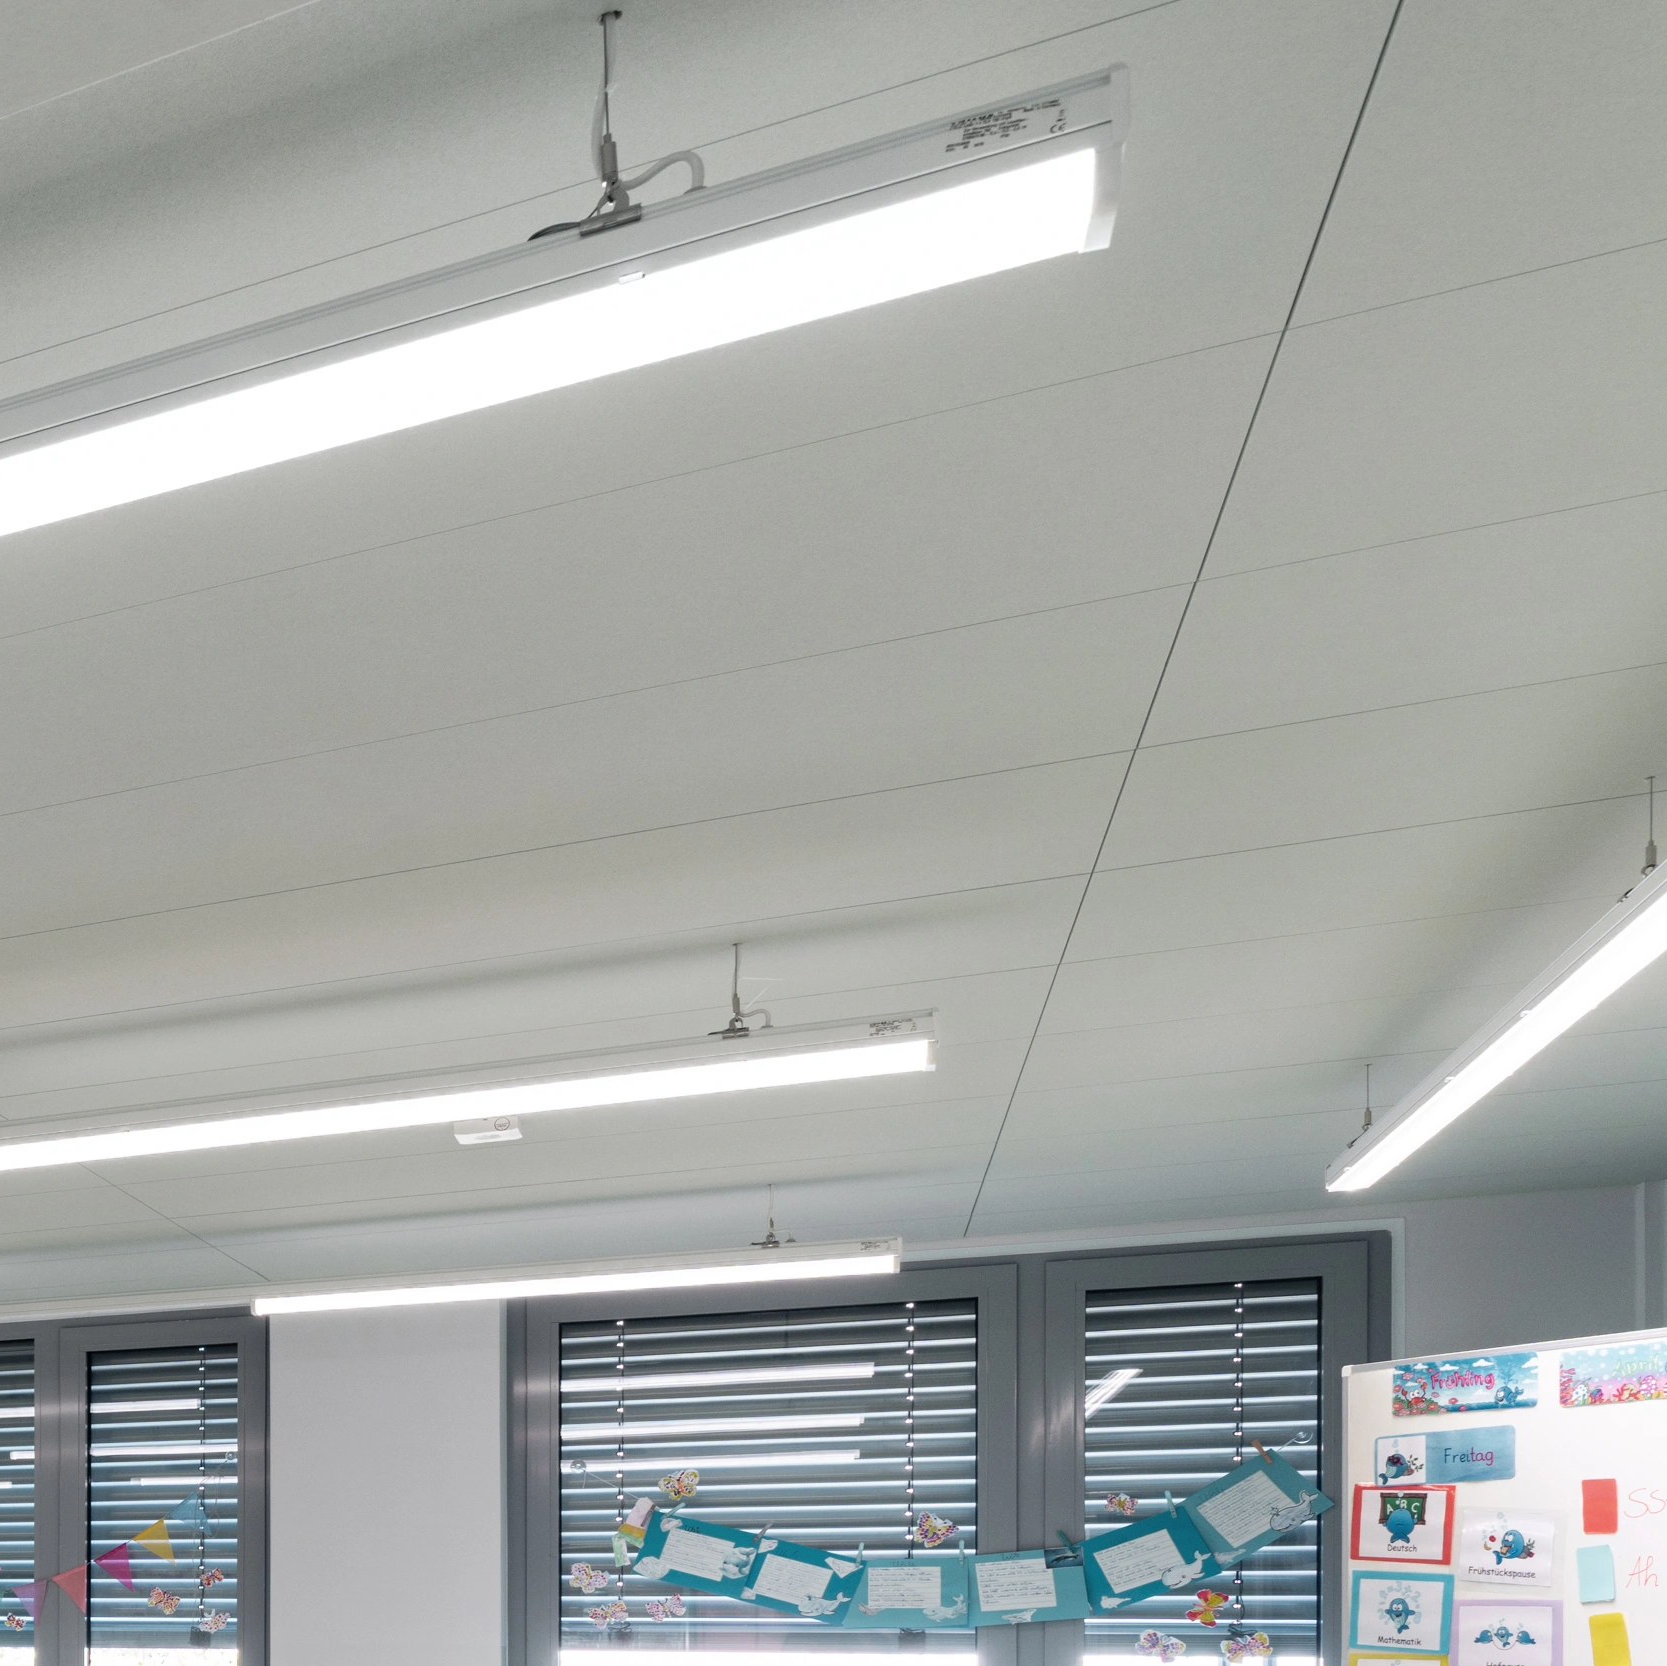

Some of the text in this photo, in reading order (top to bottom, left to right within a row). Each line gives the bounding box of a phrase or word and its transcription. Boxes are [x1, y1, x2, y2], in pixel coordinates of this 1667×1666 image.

[1611, 1353, 1661, 1377] April
[1430, 1370, 1496, 1390] Frühling
[1444, 1446, 1494, 1467] Freitag
[1386, 1544, 1418, 1553] Deutsch
[1467, 1566, 1537, 1579] Frühstückspause
[1377, 1635, 1422, 1646] Mathematik
